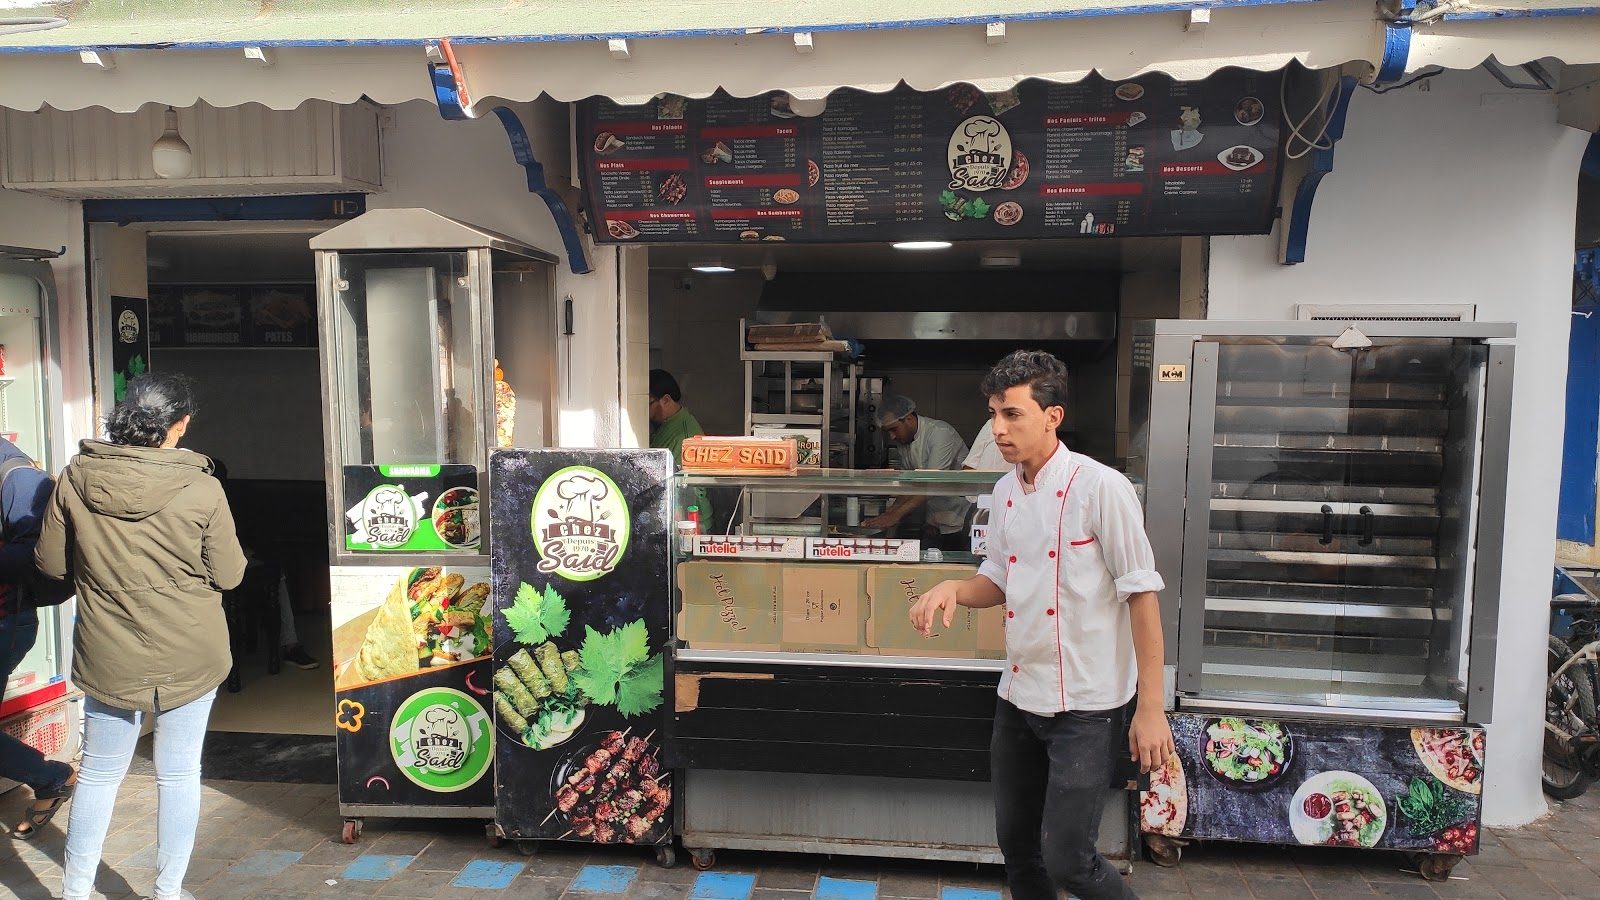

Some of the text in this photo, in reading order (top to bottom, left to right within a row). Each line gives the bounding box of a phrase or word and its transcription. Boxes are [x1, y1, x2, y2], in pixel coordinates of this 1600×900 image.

[683, 446, 733, 463] CHEZ
[739, 447, 787, 465] SAID
[538, 541, 619, 572] Said
[699, 542, 737, 554] nutella
[812, 545, 851, 557] nutella
[709, 574, 730, 597] Hot
[414, 749, 465, 769] Said
